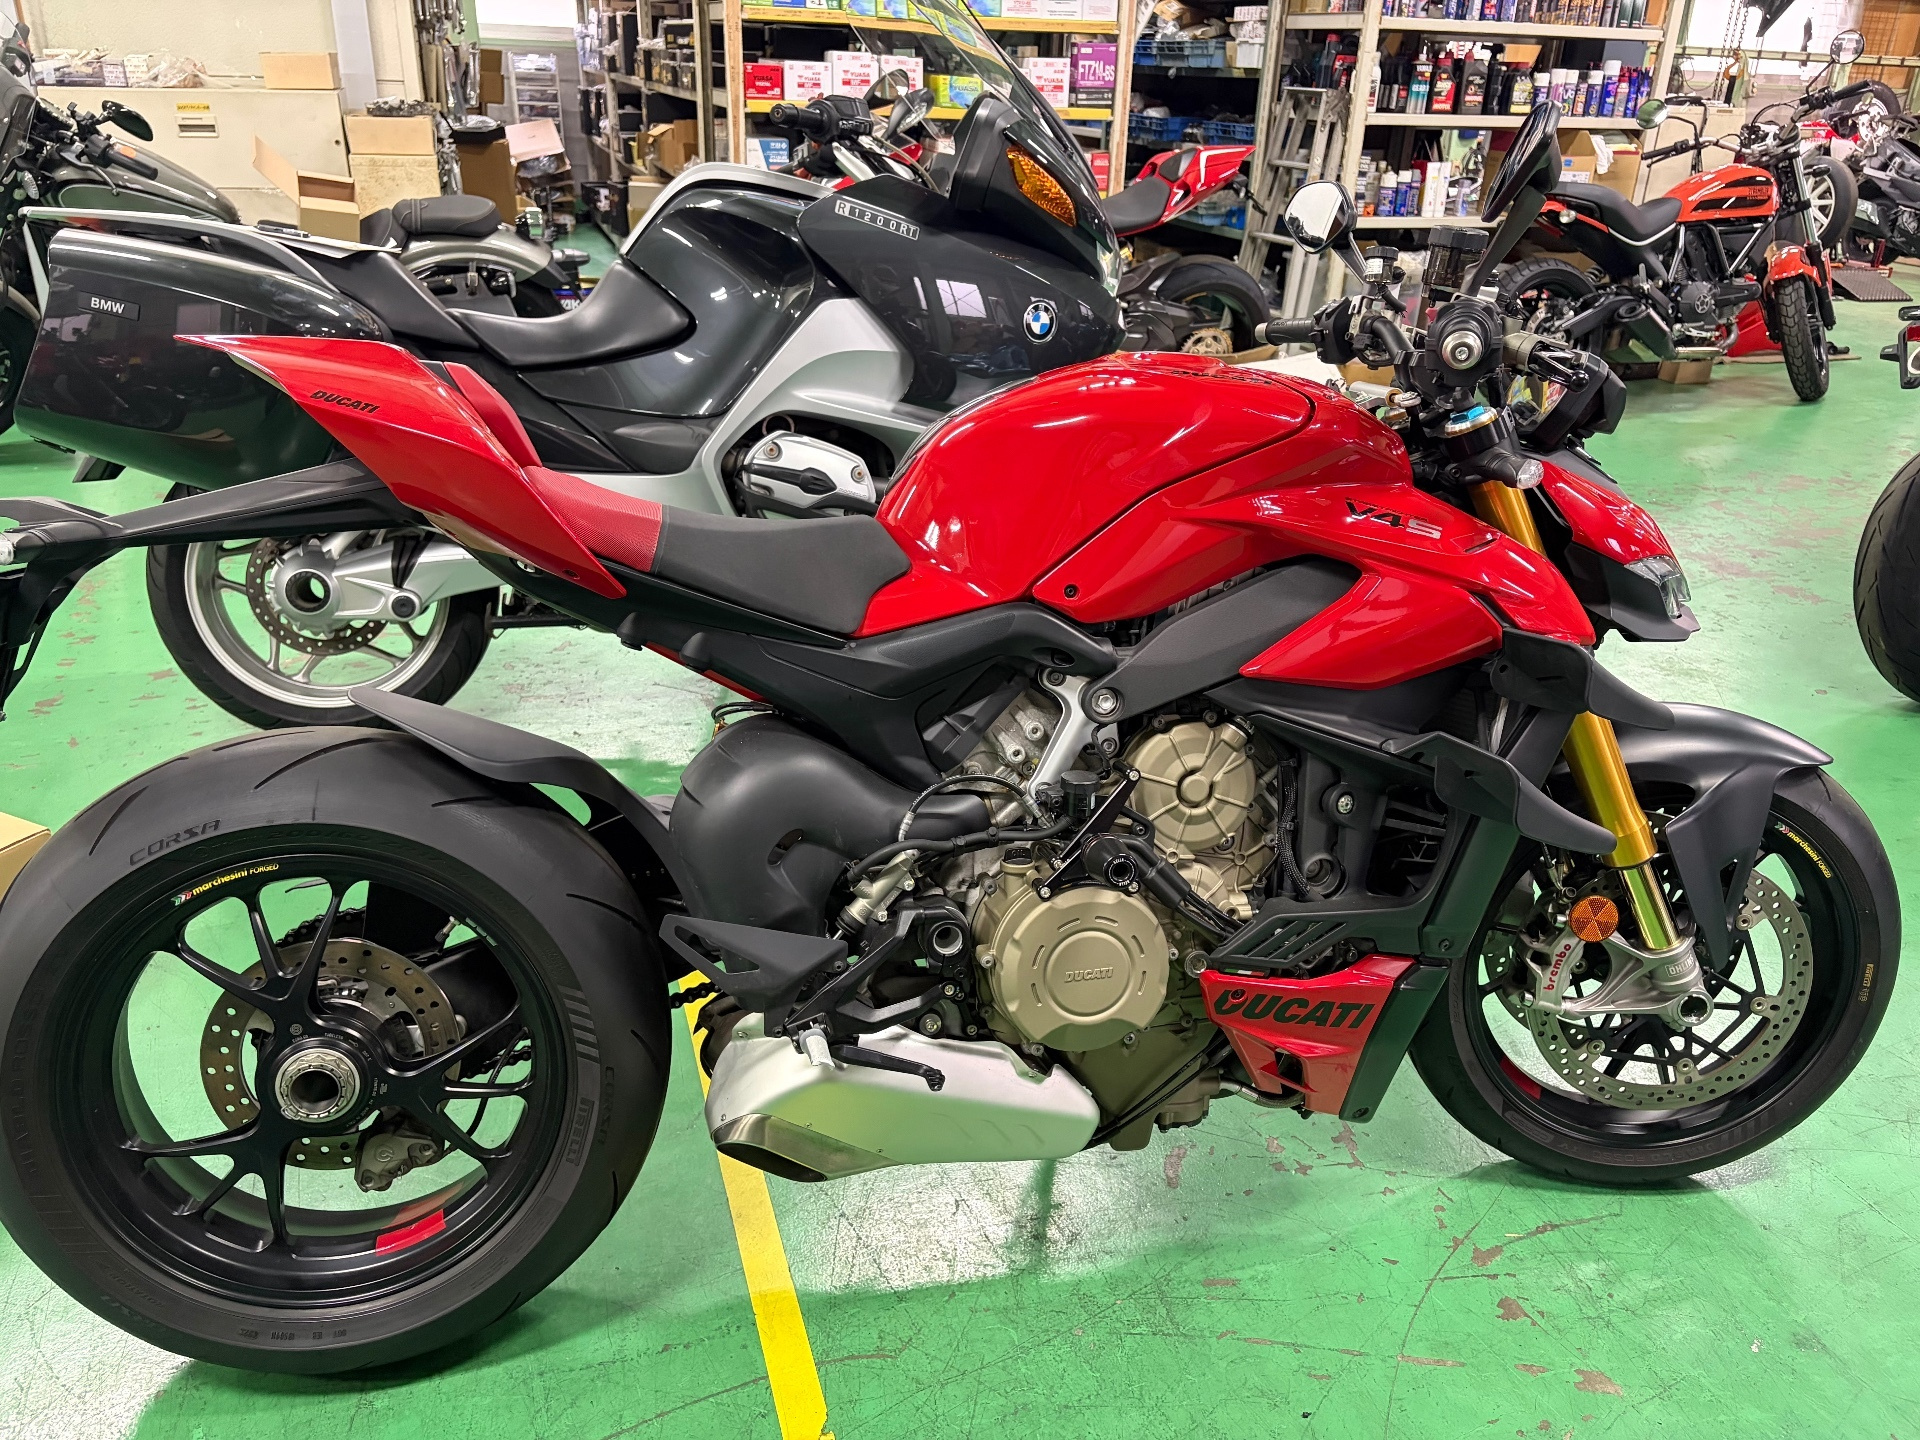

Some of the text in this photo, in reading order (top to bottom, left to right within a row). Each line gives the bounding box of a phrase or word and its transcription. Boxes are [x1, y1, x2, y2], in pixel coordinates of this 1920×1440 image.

[952, 84, 980, 92] YUASA
[90, 297, 125, 314] BMW
[310, 390, 381, 414] DUCATI
[1345, 499, 1443, 540] V4S
[129, 819, 222, 867] CORSA
[1786, 831, 1833, 879] marchesini FORGED
[191, 863, 280, 897] marchesini FORGED
[1064, 966, 1114, 983] DUCATI
[1543, 943, 1572, 991] brembo
[1213, 989, 1376, 1029] DUCATI
